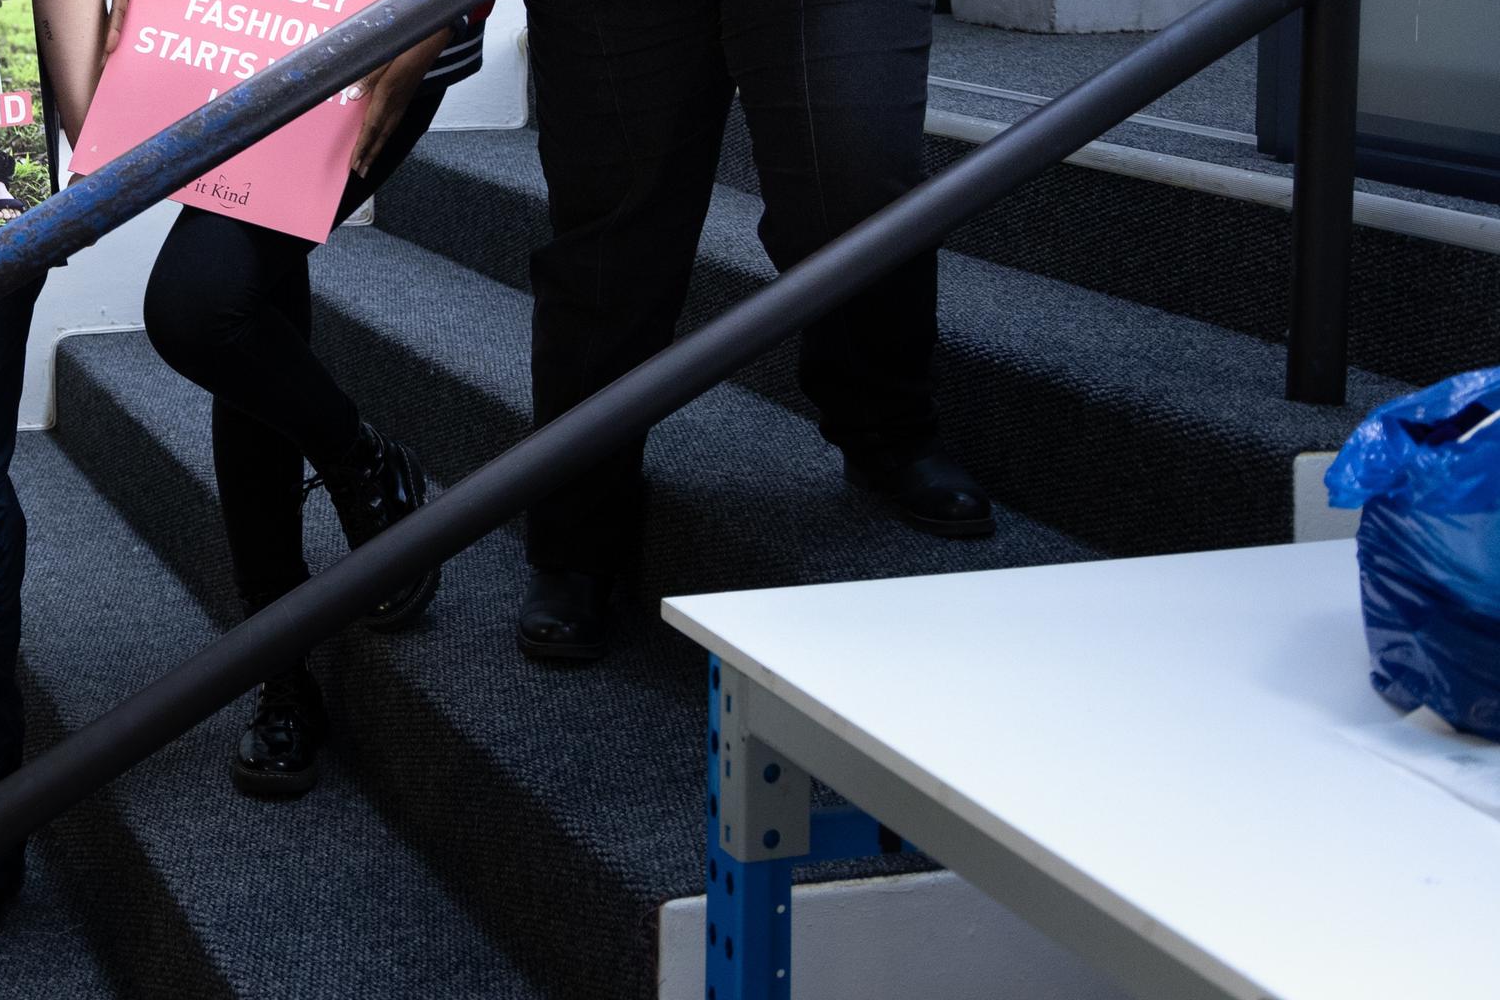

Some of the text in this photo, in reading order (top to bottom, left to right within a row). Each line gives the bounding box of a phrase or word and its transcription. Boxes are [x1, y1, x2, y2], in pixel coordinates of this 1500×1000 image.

[134, 27, 259, 80] STARTS
[194, 179, 250, 205] it Kind
